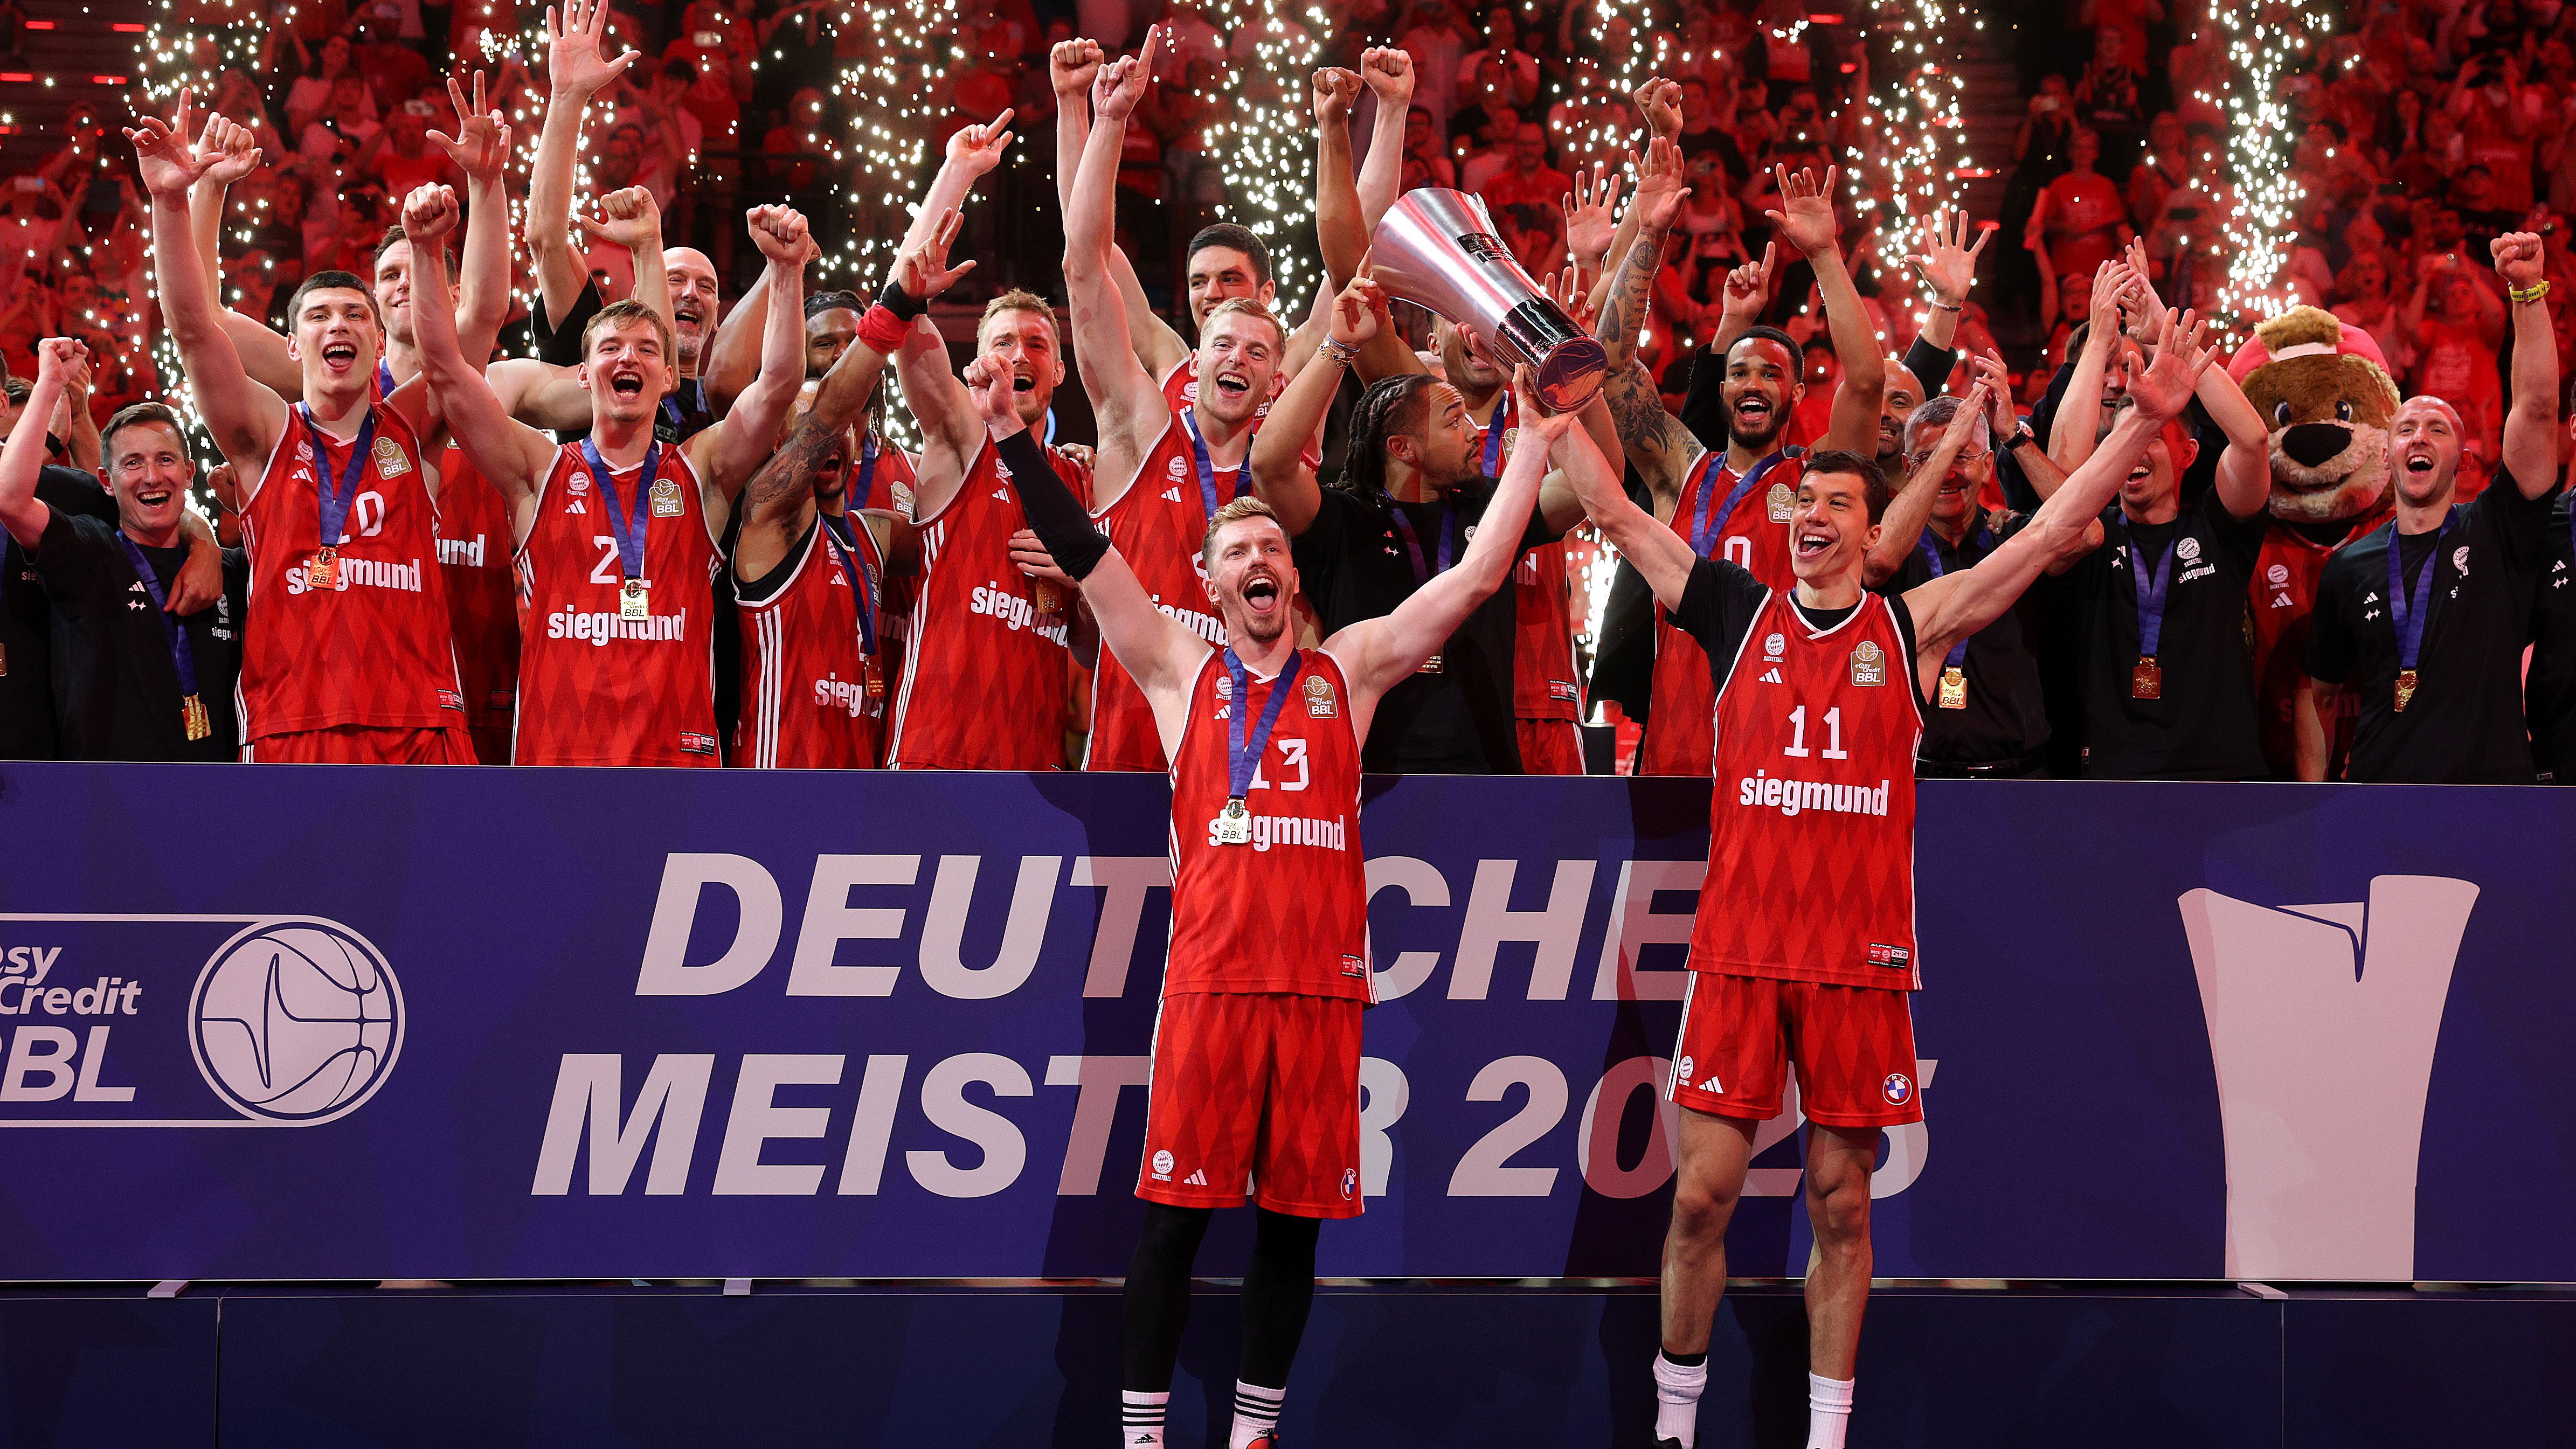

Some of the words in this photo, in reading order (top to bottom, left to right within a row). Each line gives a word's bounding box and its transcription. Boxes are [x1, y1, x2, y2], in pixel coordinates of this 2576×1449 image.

[1255, 407, 1268, 416] BL
[657, 428, 677, 441] ALP
[383, 463, 406, 475] BBL
[656, 504, 679, 514] BBL
[897, 502, 912, 514] BBL
[1772, 511, 1793, 519] BBL
[286, 558, 421, 594] sigmund
[311, 575, 332, 584] BBL
[548, 605, 685, 646] siegmund
[1855, 672, 1880, 682] BBL
[1942, 697, 1964, 705] BBL
[1312, 705, 1334, 715] BBL
[1784, 705, 1847, 760] 11
[1740, 769, 1889, 816] siegmund
[1208, 815, 1345, 851] sgmund
[1222, 830, 1242, 839] BBL
[635, 853, 1708, 1004] DEUTCHE
[0, 946, 63, 986] sy
[0, 976, 142, 1015] Credit
[0, 1026, 136, 1102] BL
[1885, 1076, 1906, 1086] BMW
[531, 1053, 1409, 1197] MEIST
[1151, 1172, 1172, 1182] BASKETBALL
